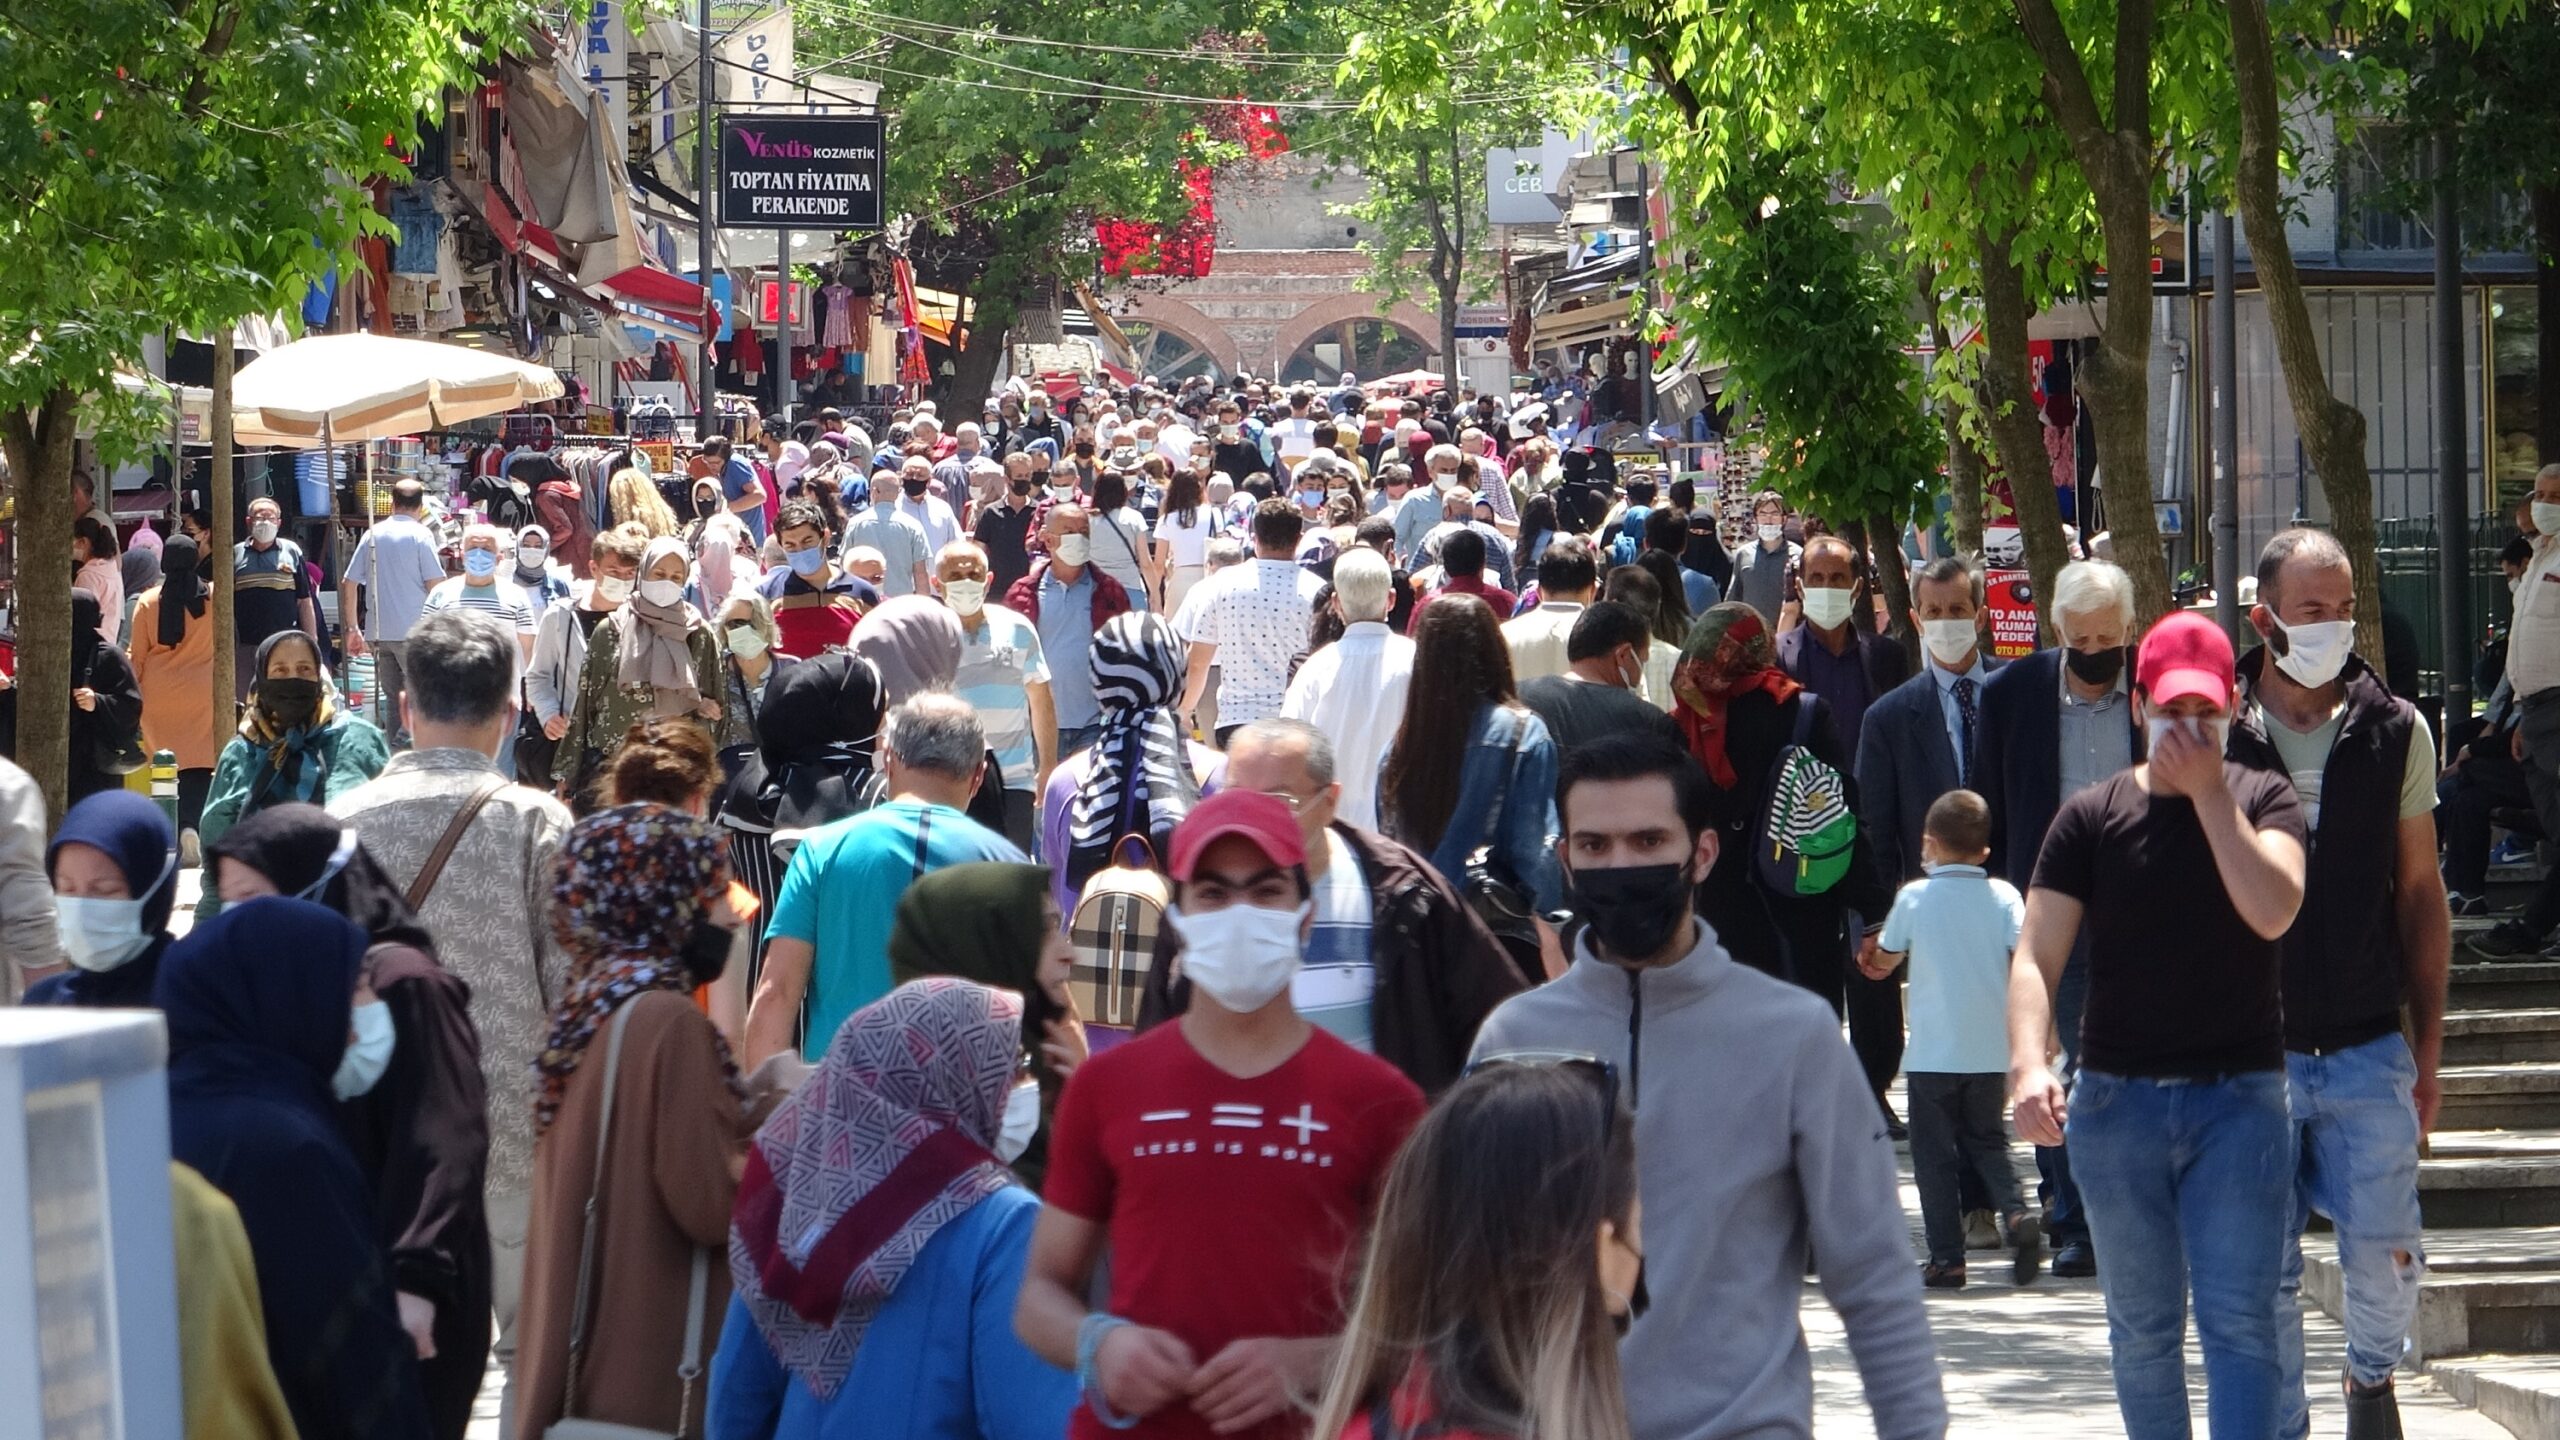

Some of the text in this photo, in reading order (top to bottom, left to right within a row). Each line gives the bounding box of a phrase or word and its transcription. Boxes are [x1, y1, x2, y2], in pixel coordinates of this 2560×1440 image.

[735, 127, 875, 160] VENÜS KOZMETİK
[729, 168, 871, 191] TOPTAN FİYATINA
[752, 196, 849, 215] PERAKENDE
[2007, 610, 2036, 621] ANA
[1992, 631, 2034, 642] YEDEK
